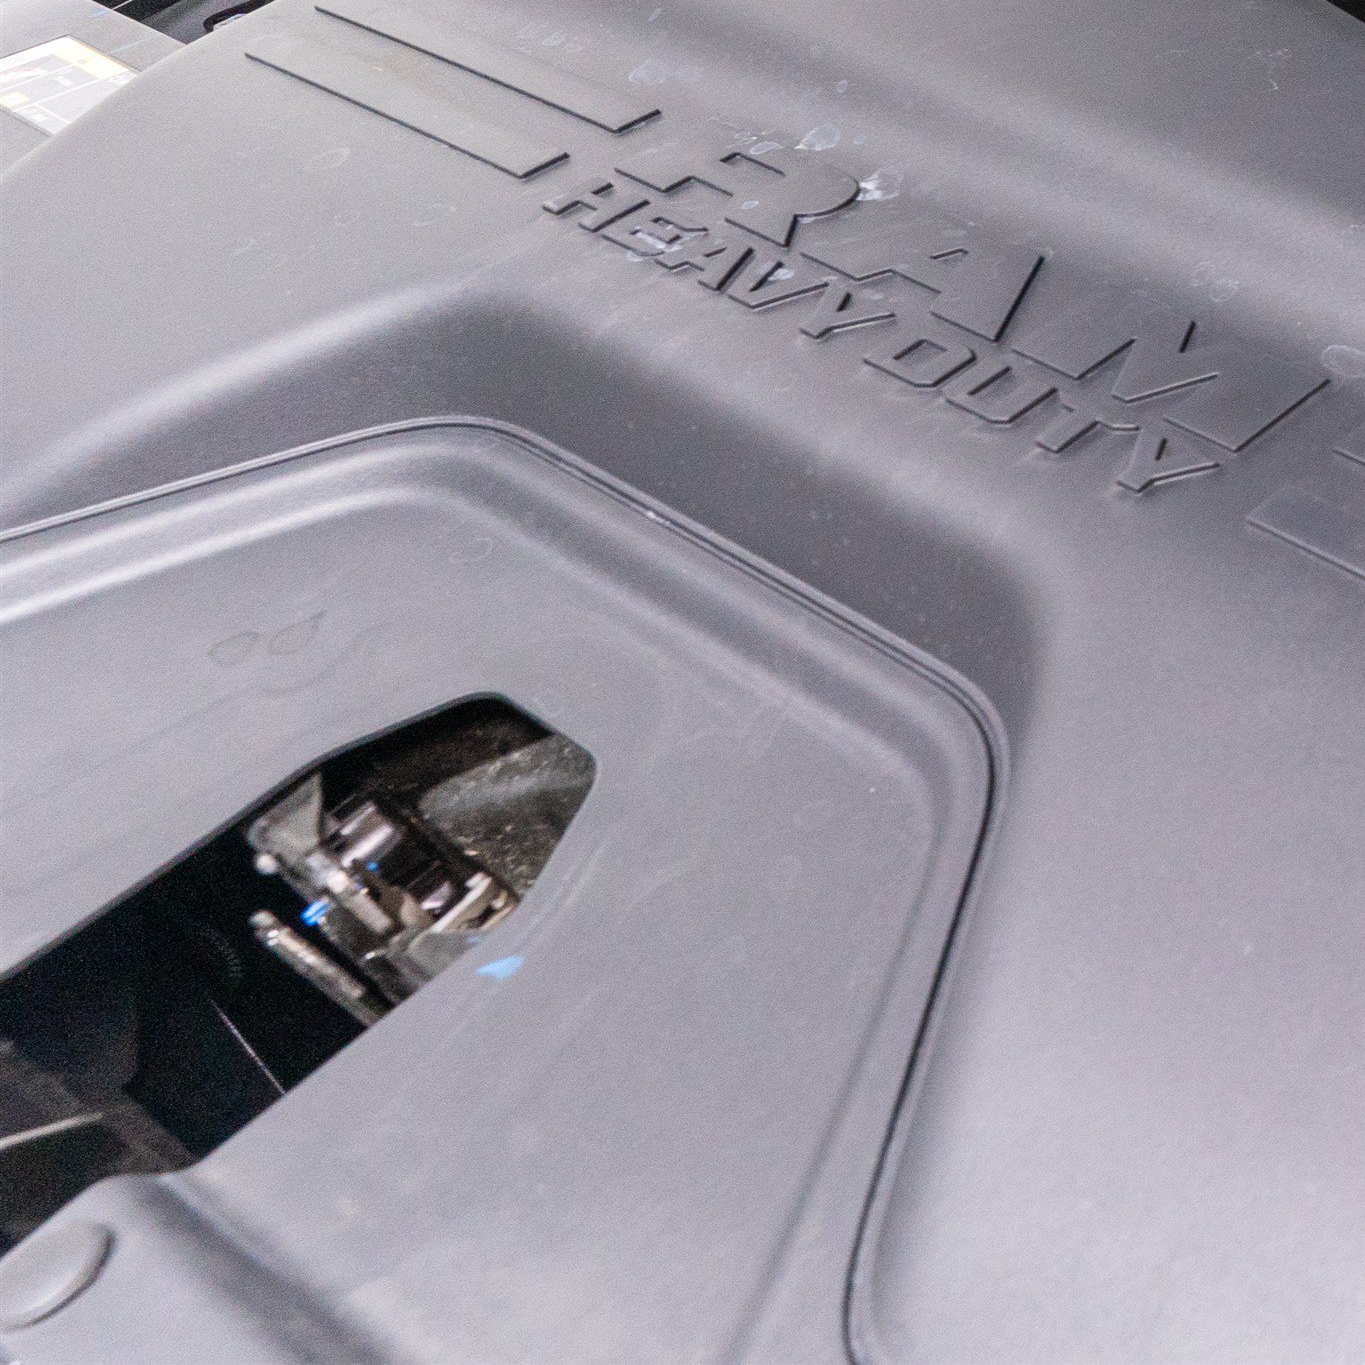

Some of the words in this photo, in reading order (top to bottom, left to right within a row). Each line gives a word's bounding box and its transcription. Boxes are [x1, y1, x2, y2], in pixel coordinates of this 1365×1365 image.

[542, 182, 897, 340] HEAVY
[862, 336, 1221, 495] DUTY
[614, 149, 1334, 454] RAM
